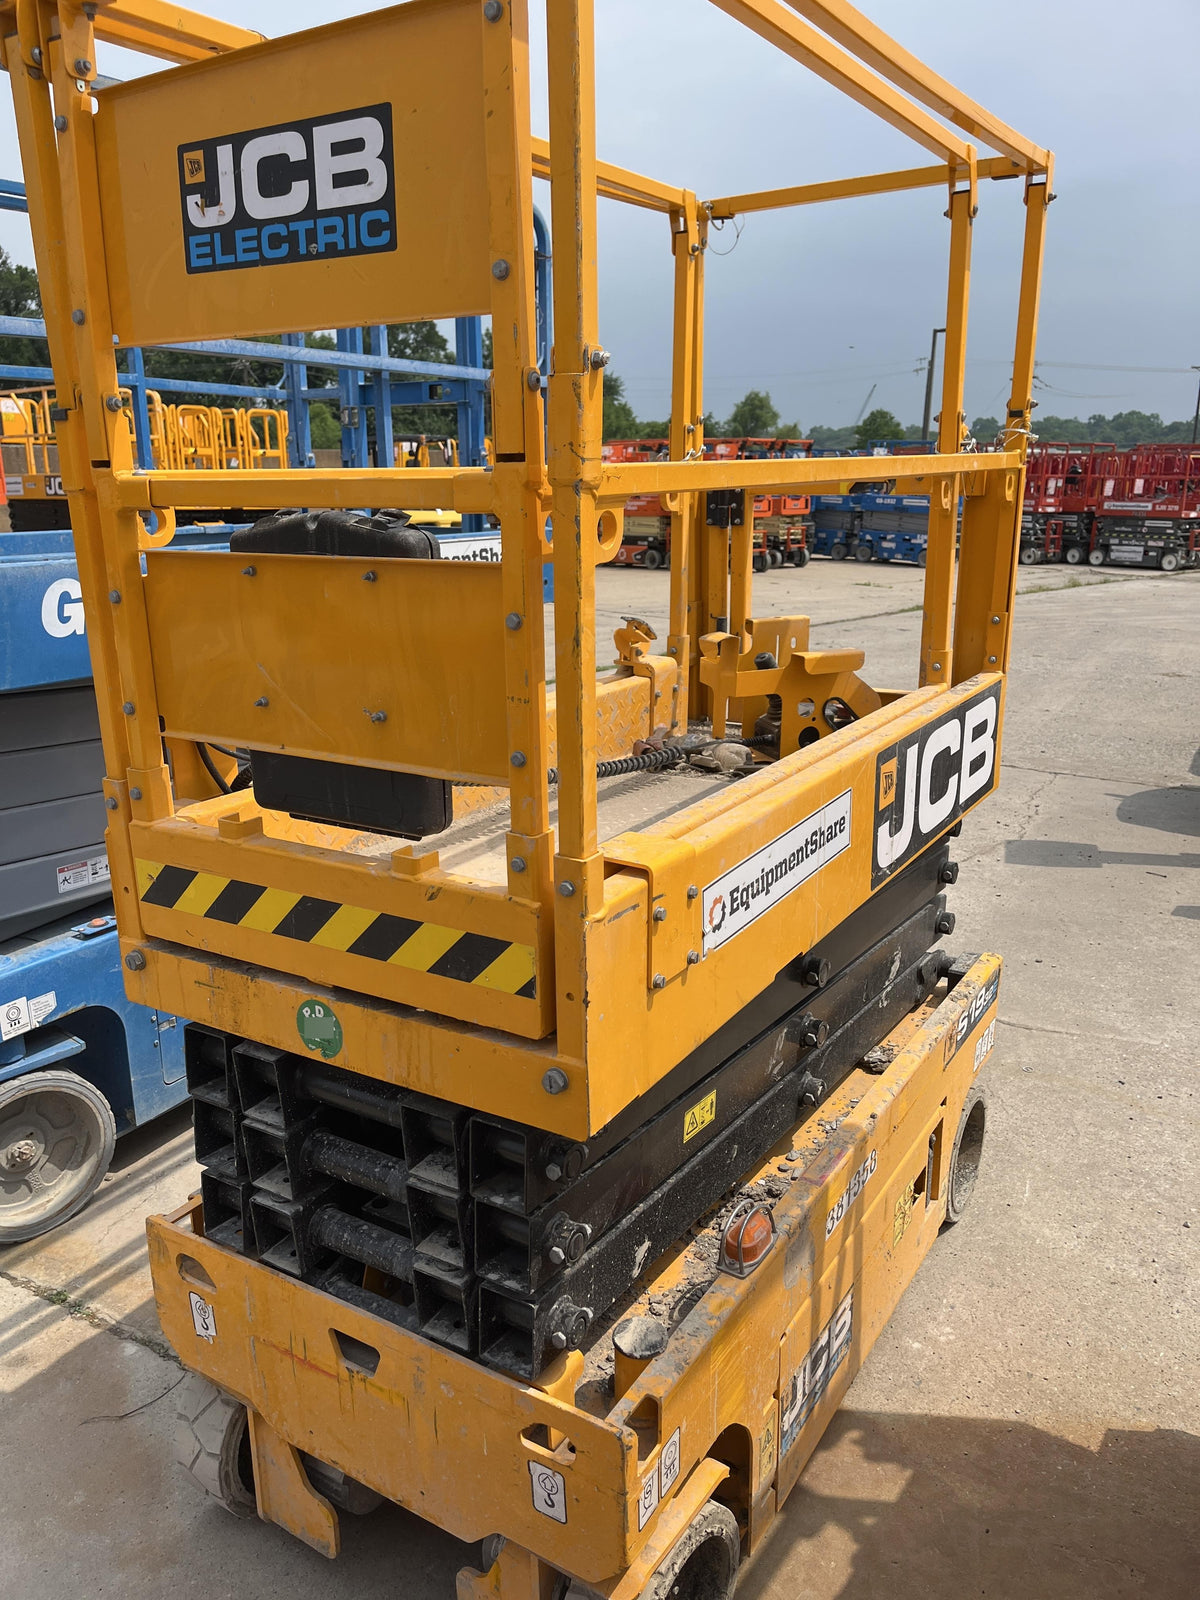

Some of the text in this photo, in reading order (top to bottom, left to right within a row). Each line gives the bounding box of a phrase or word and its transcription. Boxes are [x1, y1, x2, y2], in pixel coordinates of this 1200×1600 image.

[187, 116, 388, 228] JCB
[189, 210, 391, 268] ELECTRIC
[877, 696, 997, 868] JCB
[729, 815, 846, 917] EquipmentShare
[782, 1294, 852, 1432] JCB
